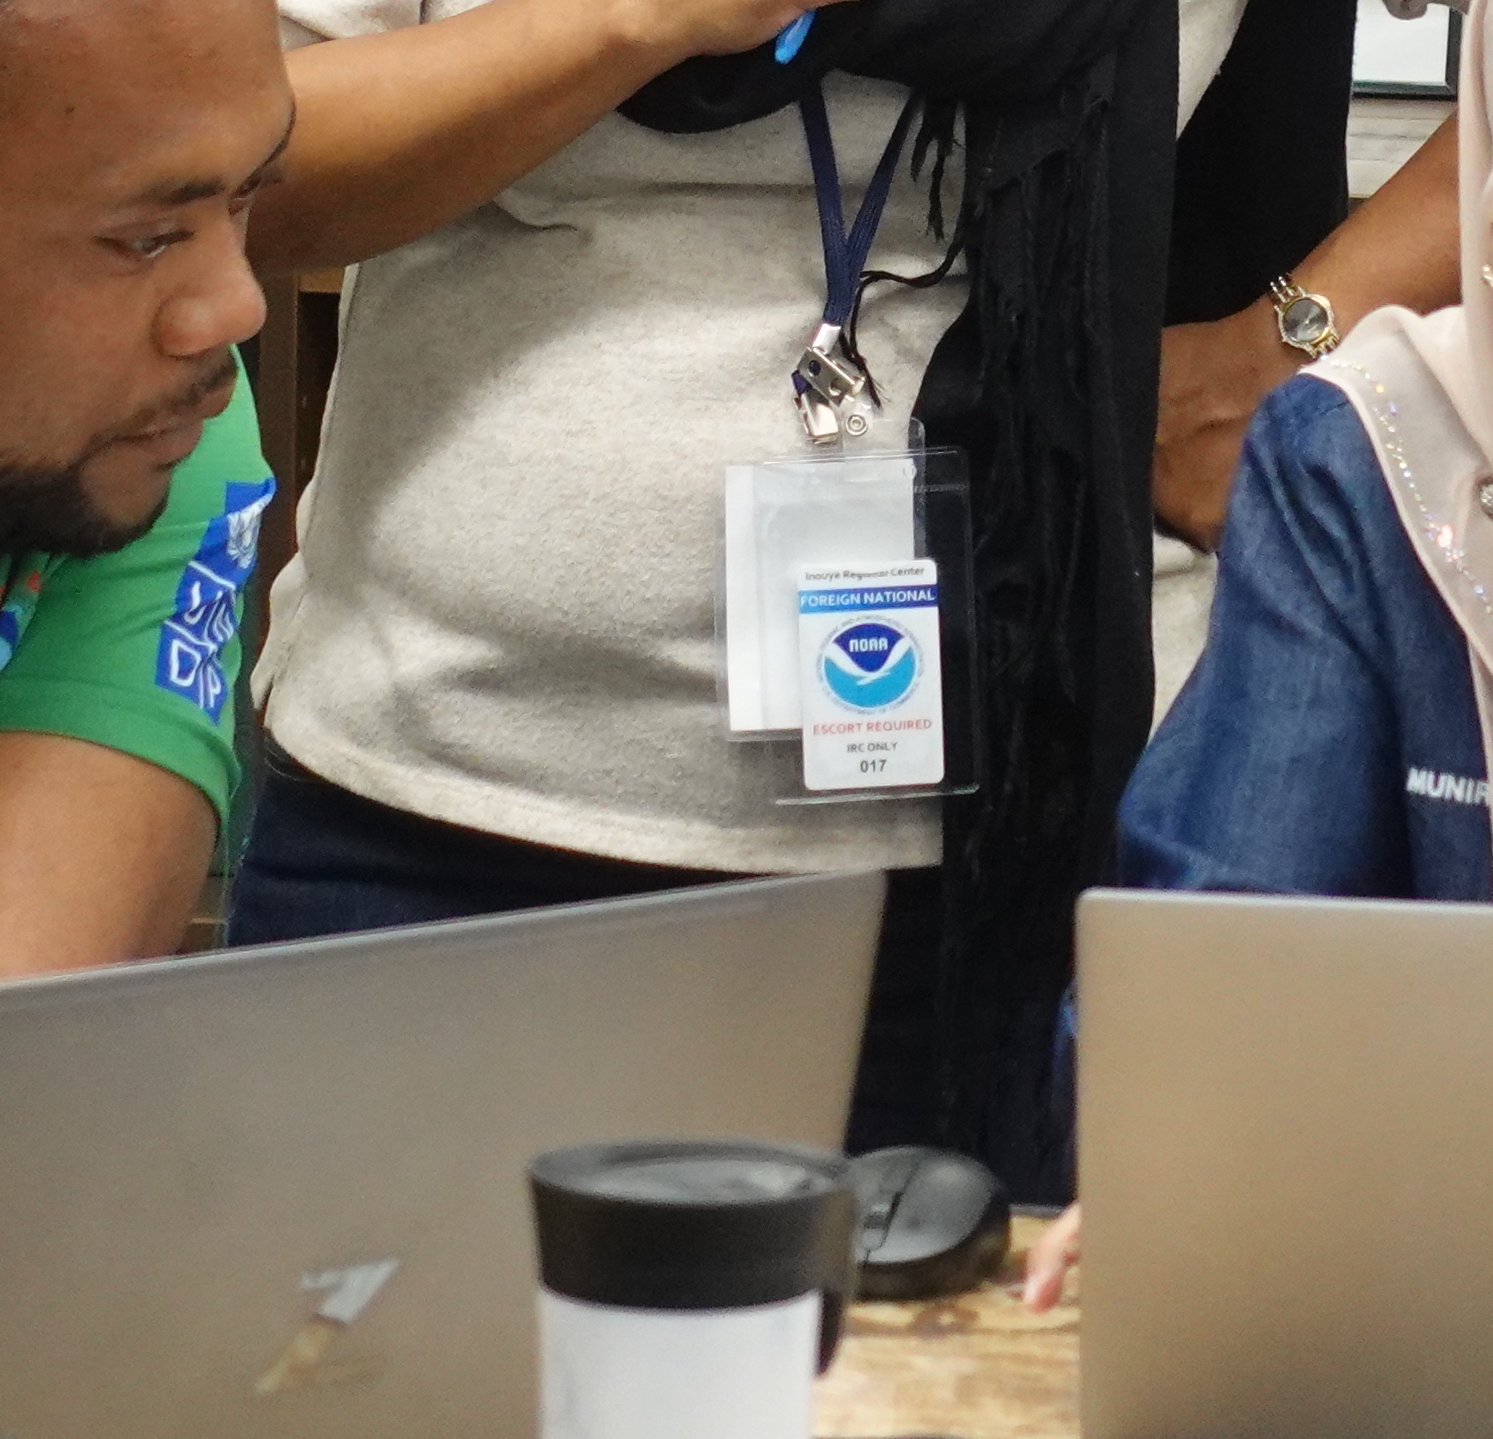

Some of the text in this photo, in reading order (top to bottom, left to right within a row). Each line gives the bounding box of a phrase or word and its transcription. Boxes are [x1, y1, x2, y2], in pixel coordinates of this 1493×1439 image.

[890, 567, 925, 577] Center
[800, 588, 936, 607] FOREIGN NATIONAL
[813, 718, 932, 736] ESCORT REQUIRED
[847, 741, 898, 754] IRC ONLY
[860, 759, 887, 773] 017
